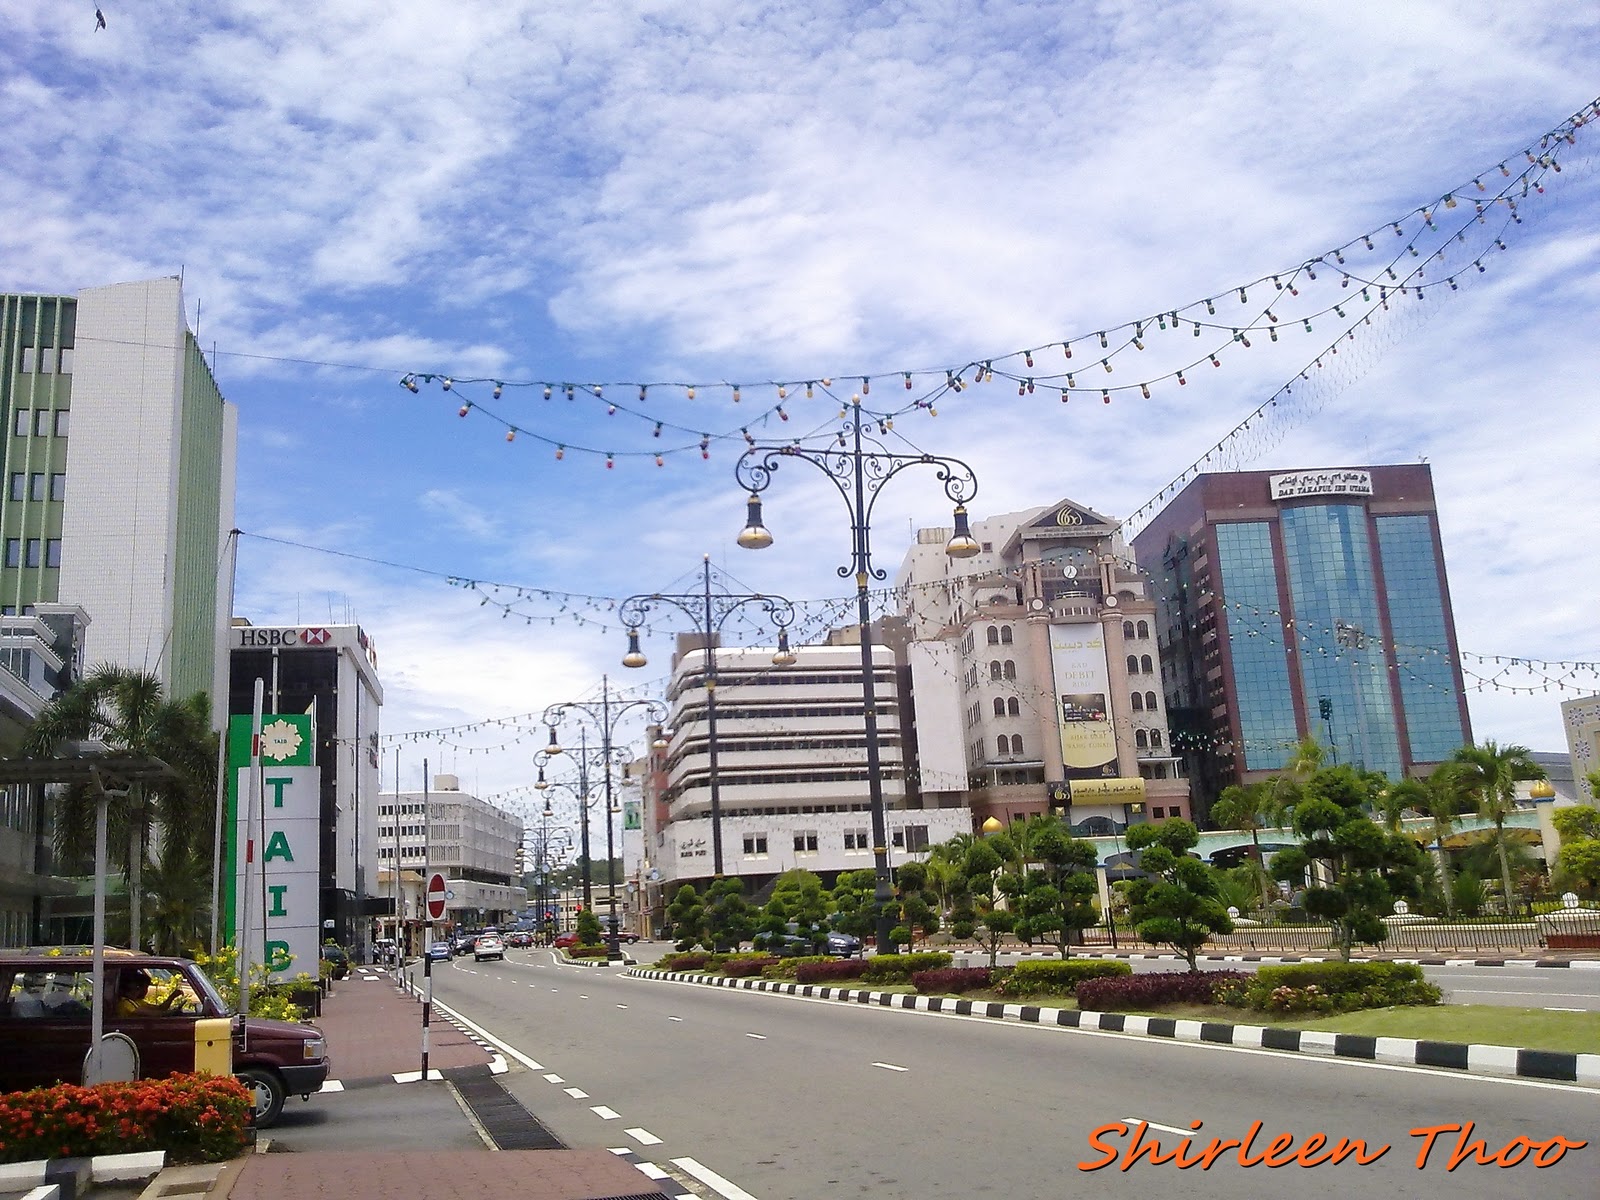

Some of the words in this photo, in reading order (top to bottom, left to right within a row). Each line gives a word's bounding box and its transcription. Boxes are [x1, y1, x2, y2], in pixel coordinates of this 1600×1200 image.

[1278, 488, 1294, 497] DAR
[1297, 485, 1332, 495] TAKAFUL
[1349, 484, 1370, 493] UTAMA
[240, 629, 297, 646] HSBC
[1065, 670, 1096, 679] DEBIT
[264, 777, 294, 972] TAIB
